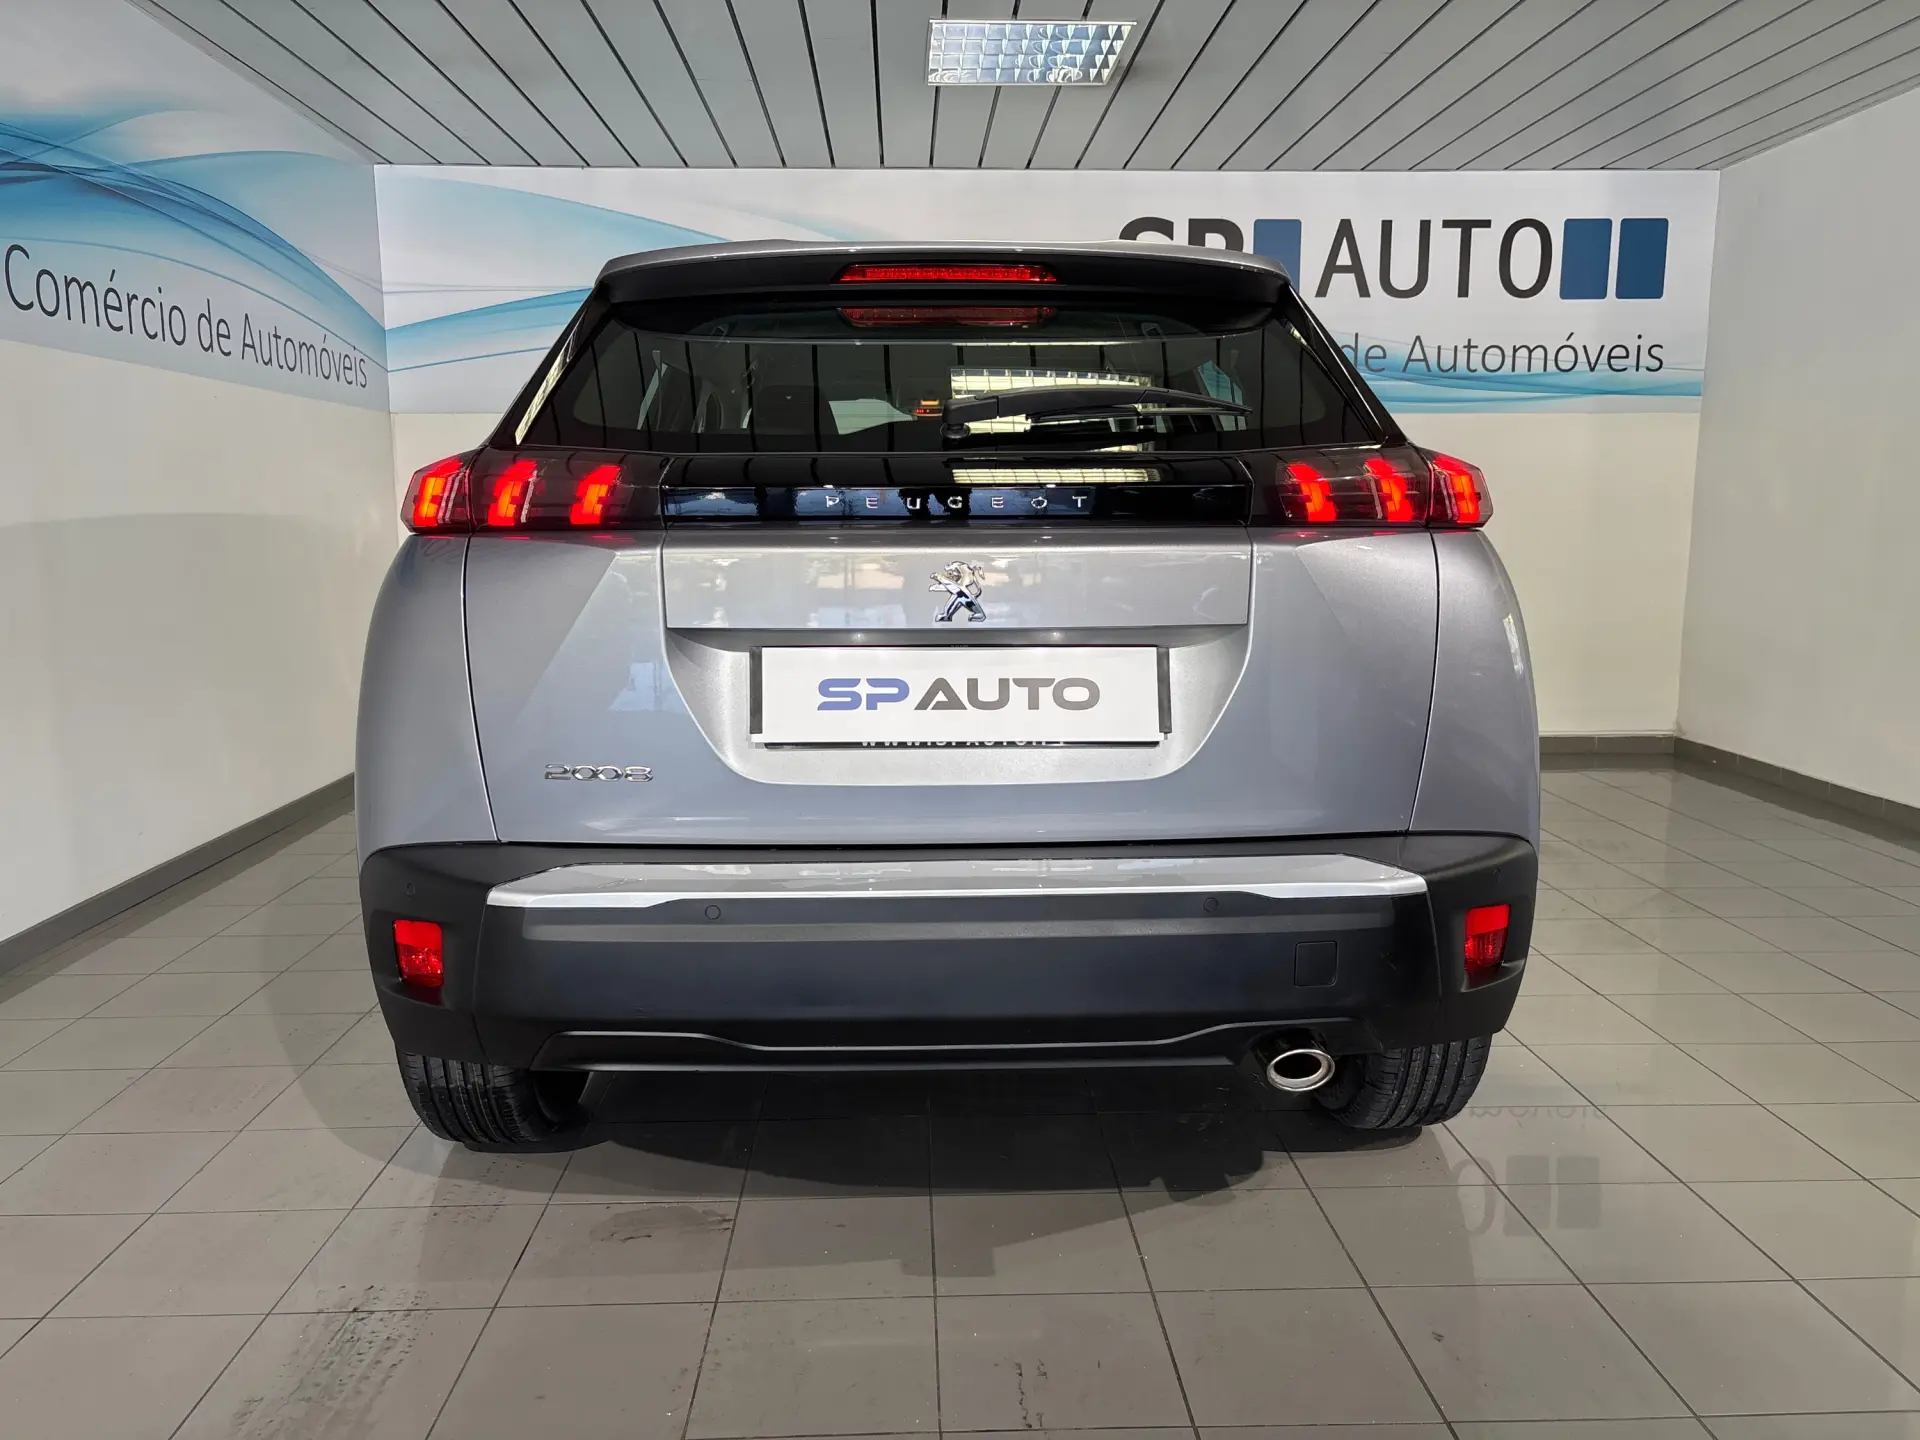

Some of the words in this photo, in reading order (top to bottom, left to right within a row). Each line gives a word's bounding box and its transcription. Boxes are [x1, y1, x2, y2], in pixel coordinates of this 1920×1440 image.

[1314, 218, 1554, 299] AUTO
[5, 244, 187, 346] Comércio
[197, 298, 232, 357] de
[241, 313, 368, 389] Automóveis
[1401, 331, 1665, 374] Automóveis
[825, 494, 1089, 511] PEUGEOT
[544, 763, 653, 782] 2008
